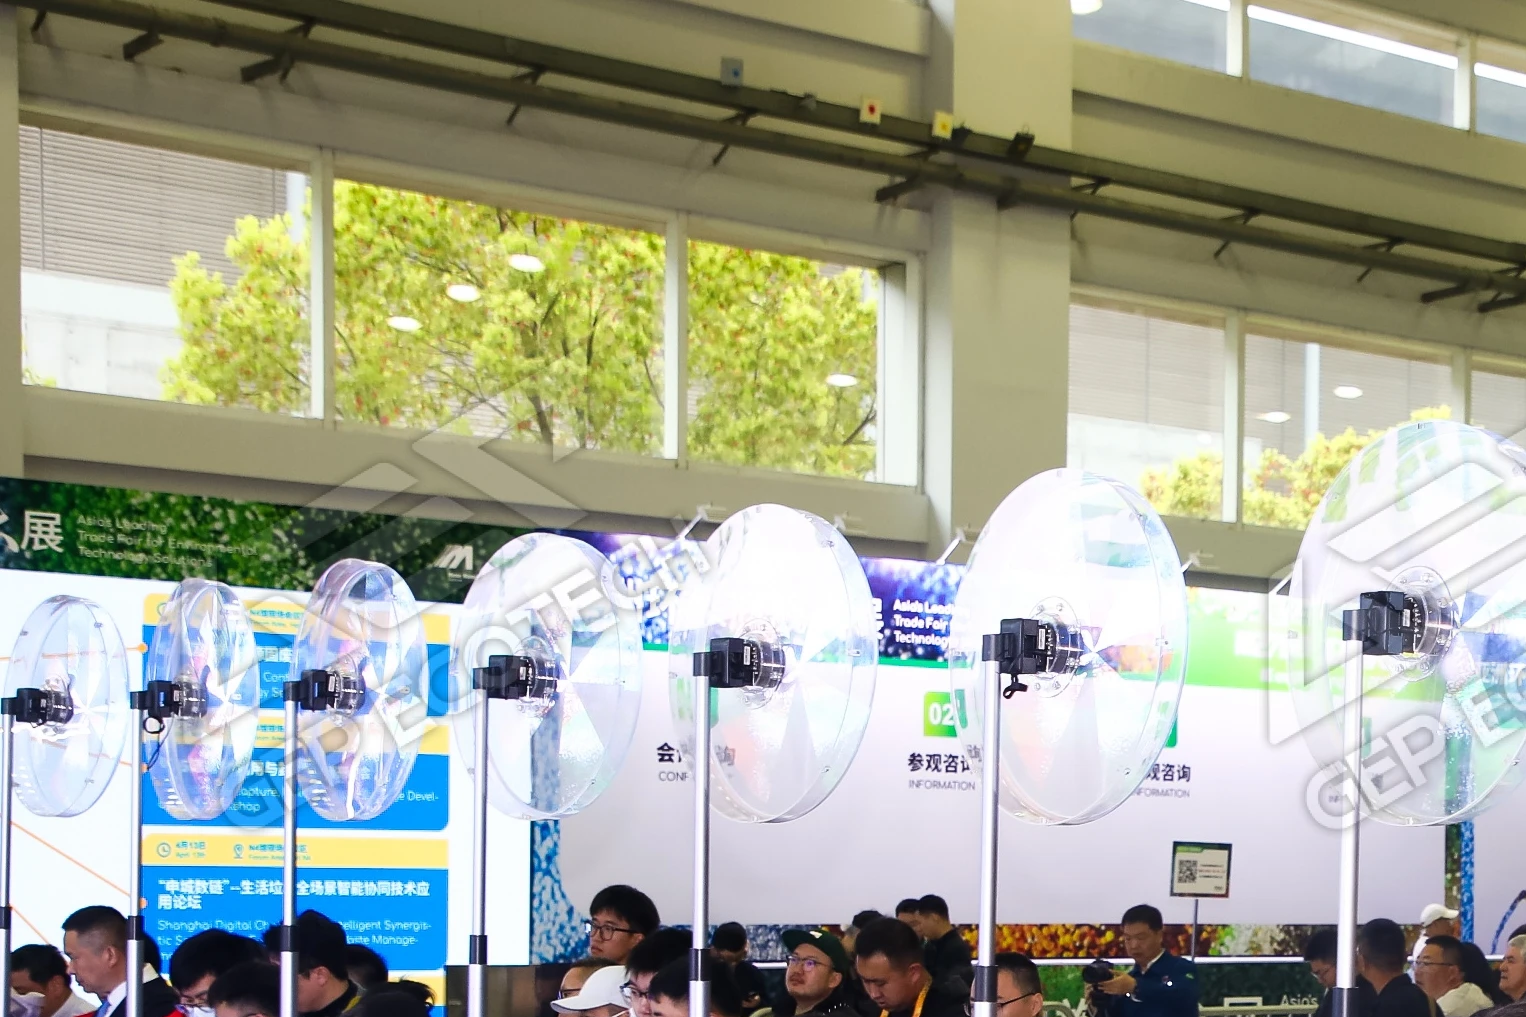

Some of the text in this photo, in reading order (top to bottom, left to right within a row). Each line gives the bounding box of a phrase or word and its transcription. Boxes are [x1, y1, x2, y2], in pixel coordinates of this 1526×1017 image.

[78, 530, 114, 545] Trade
[117, 534, 142, 546] Fair
[894, 615, 949, 631] Trade Fair
[894, 630, 950, 648] Technolog
[1143, 763, 1191, 783] 观咨询
[908, 779, 976, 792] INFORMATION
[158, 895, 202, 910] 用论坛
[158, 919, 211, 932] Shanghai
[215, 920, 252, 932] Digital
